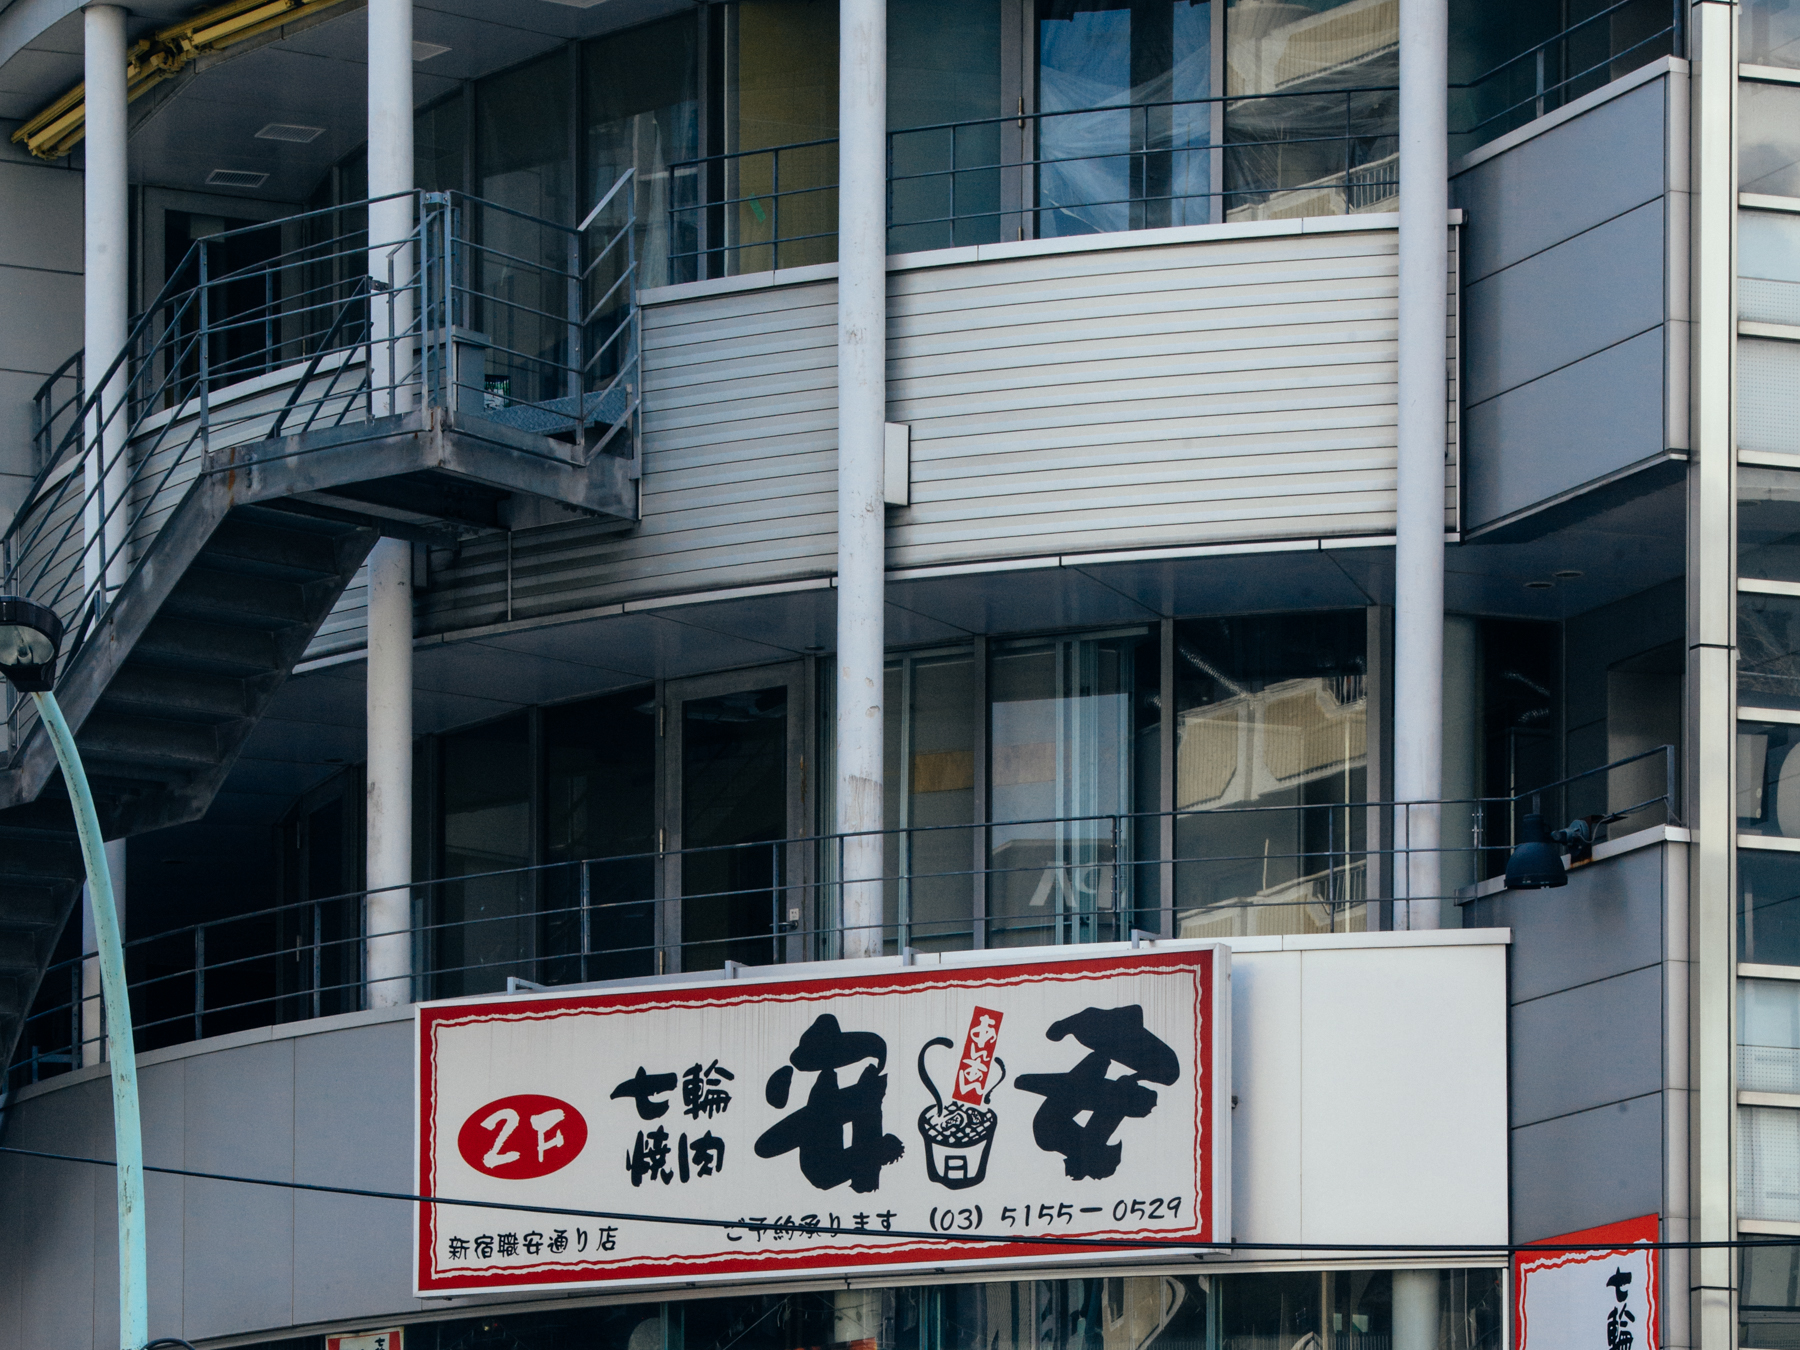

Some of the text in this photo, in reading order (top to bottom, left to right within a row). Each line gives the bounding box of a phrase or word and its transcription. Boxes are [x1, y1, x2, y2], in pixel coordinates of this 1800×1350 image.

[610, 1059, 732, 1121] 七輪
[478, 1107, 565, 1164] 2F
[626, 1129, 726, 1187] 焼肉
[448, 1225, 618, 1262] 新宿職安通り店
[723, 1211, 898, 1244] ご予約承ります
[929, 1205, 983, 1233] (03)
